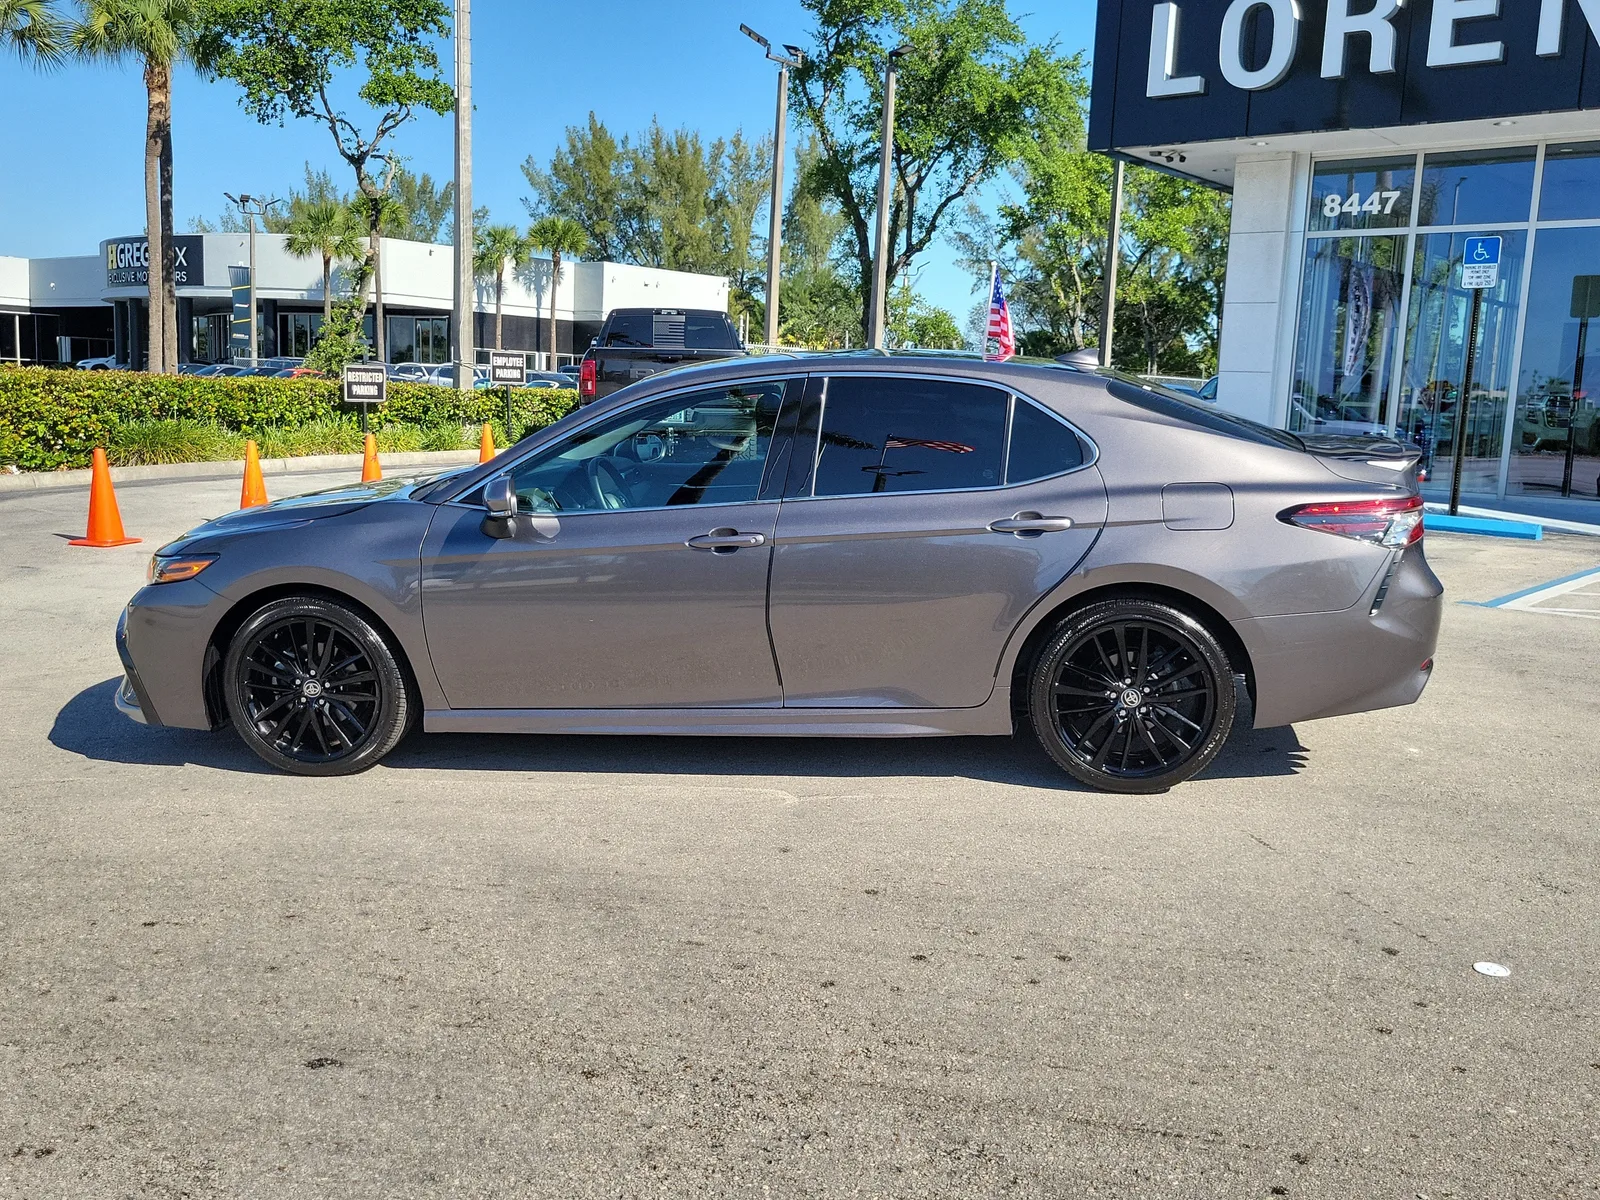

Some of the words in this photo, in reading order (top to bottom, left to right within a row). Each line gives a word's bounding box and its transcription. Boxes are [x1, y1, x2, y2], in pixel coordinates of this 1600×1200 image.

[1323, 190, 1401, 217] 8447
[107, 242, 149, 270] HGREG
[493, 356, 524, 367] EMPLOYEE
[347, 371, 383, 383] RESTRICTED
[495, 368, 521, 379] PARKING
[352, 384, 379, 396] PARKING
